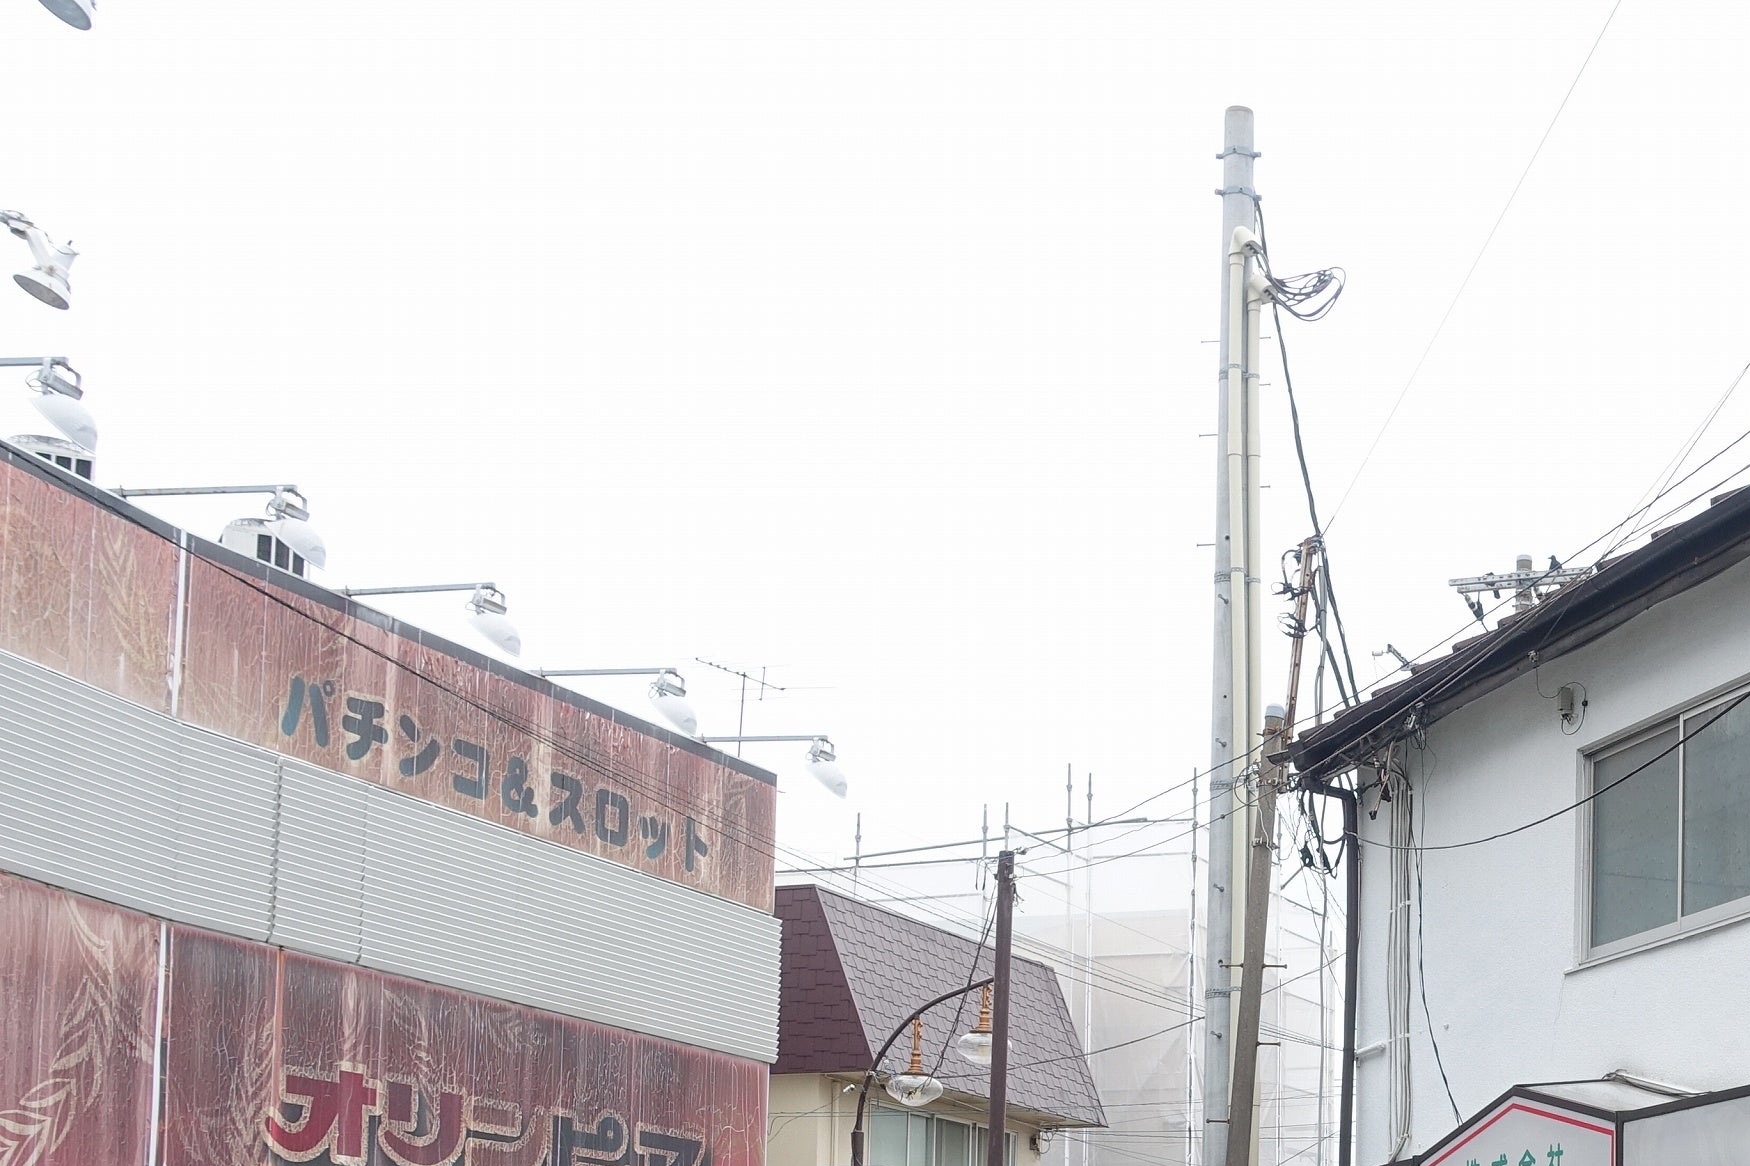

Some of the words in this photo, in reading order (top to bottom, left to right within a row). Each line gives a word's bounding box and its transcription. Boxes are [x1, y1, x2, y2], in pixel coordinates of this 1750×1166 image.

[281, 674, 709, 872] パチンコ&スロット
